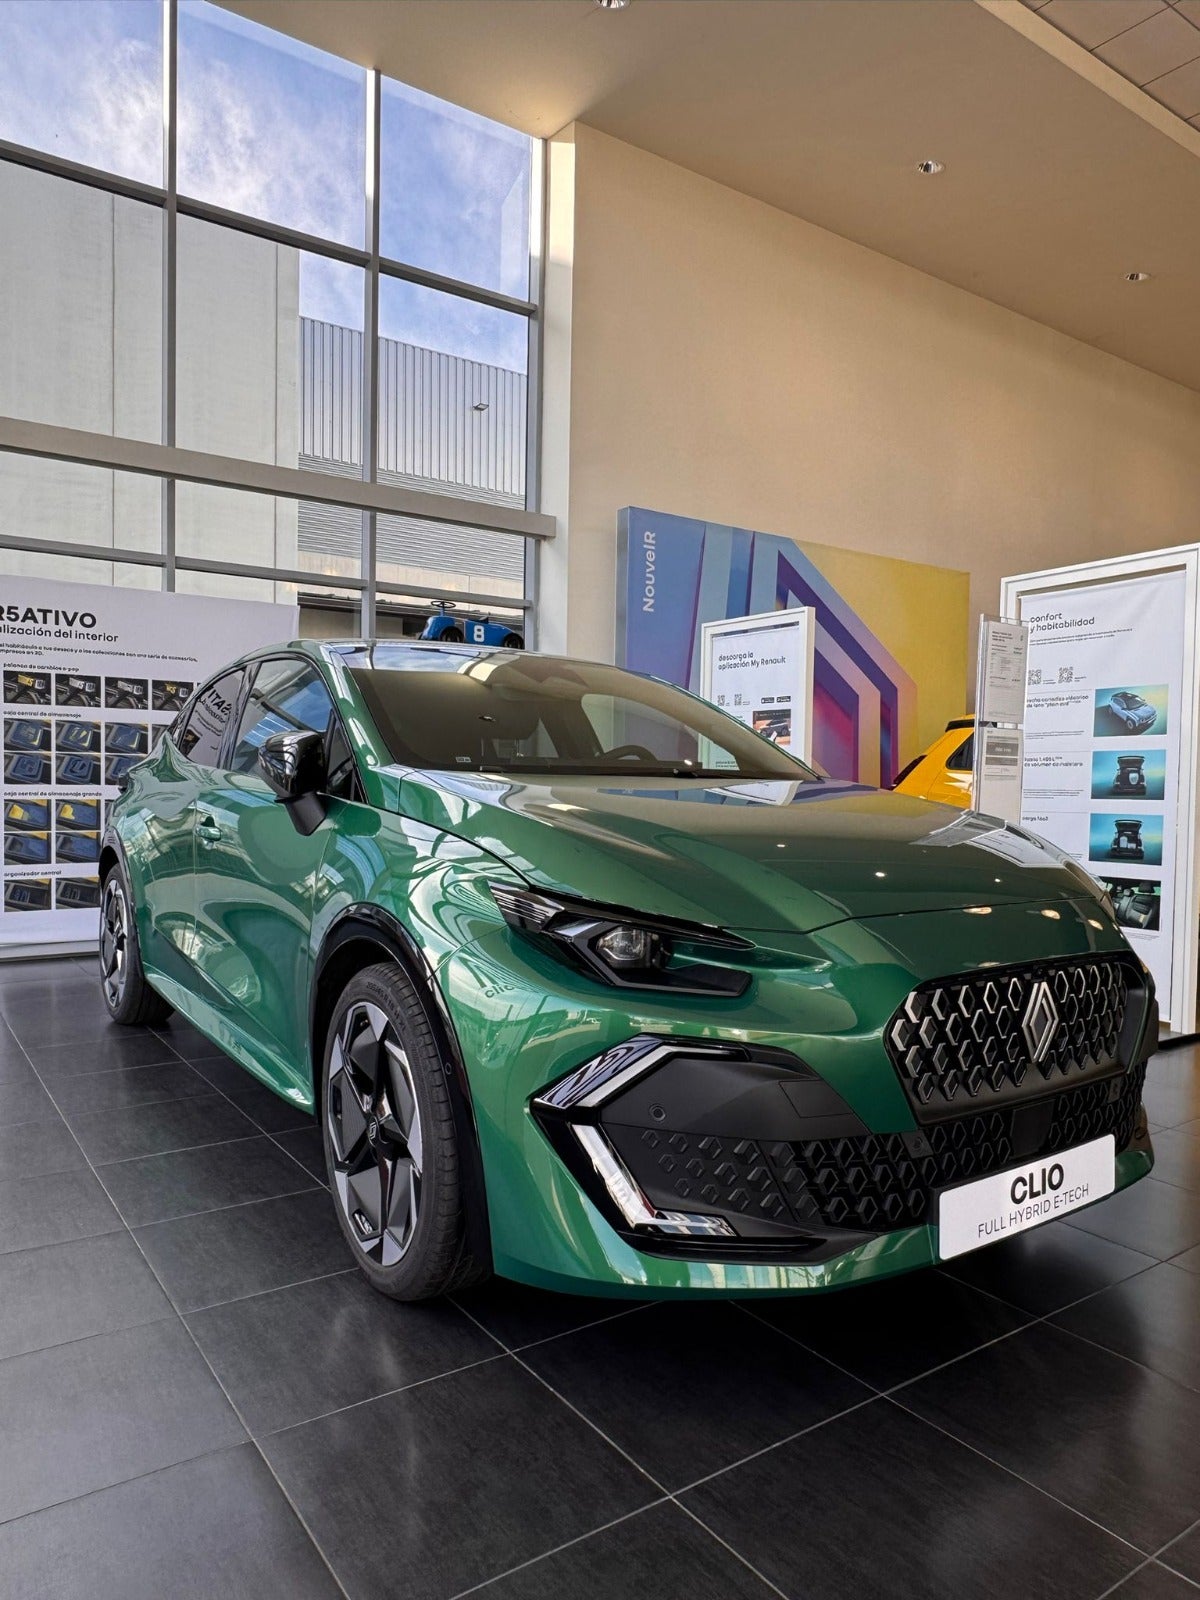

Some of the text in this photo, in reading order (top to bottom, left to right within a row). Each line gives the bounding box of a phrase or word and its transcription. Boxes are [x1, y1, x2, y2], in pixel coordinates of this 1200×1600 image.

[1030, 612, 1062, 623] confort
[1030, 617, 1095, 634] y habitabilidad
[54, 629, 72, 638] del
[75, 630, 118, 642] interior
[473, 625, 484, 642] 8
[718, 652, 747, 662] descarga
[718, 656, 786, 671] aplicación My Renault
[1010, 1163, 1064, 1204] CLIO
[978, 1183, 1090, 1238] FULL HYBRID E-TECH
